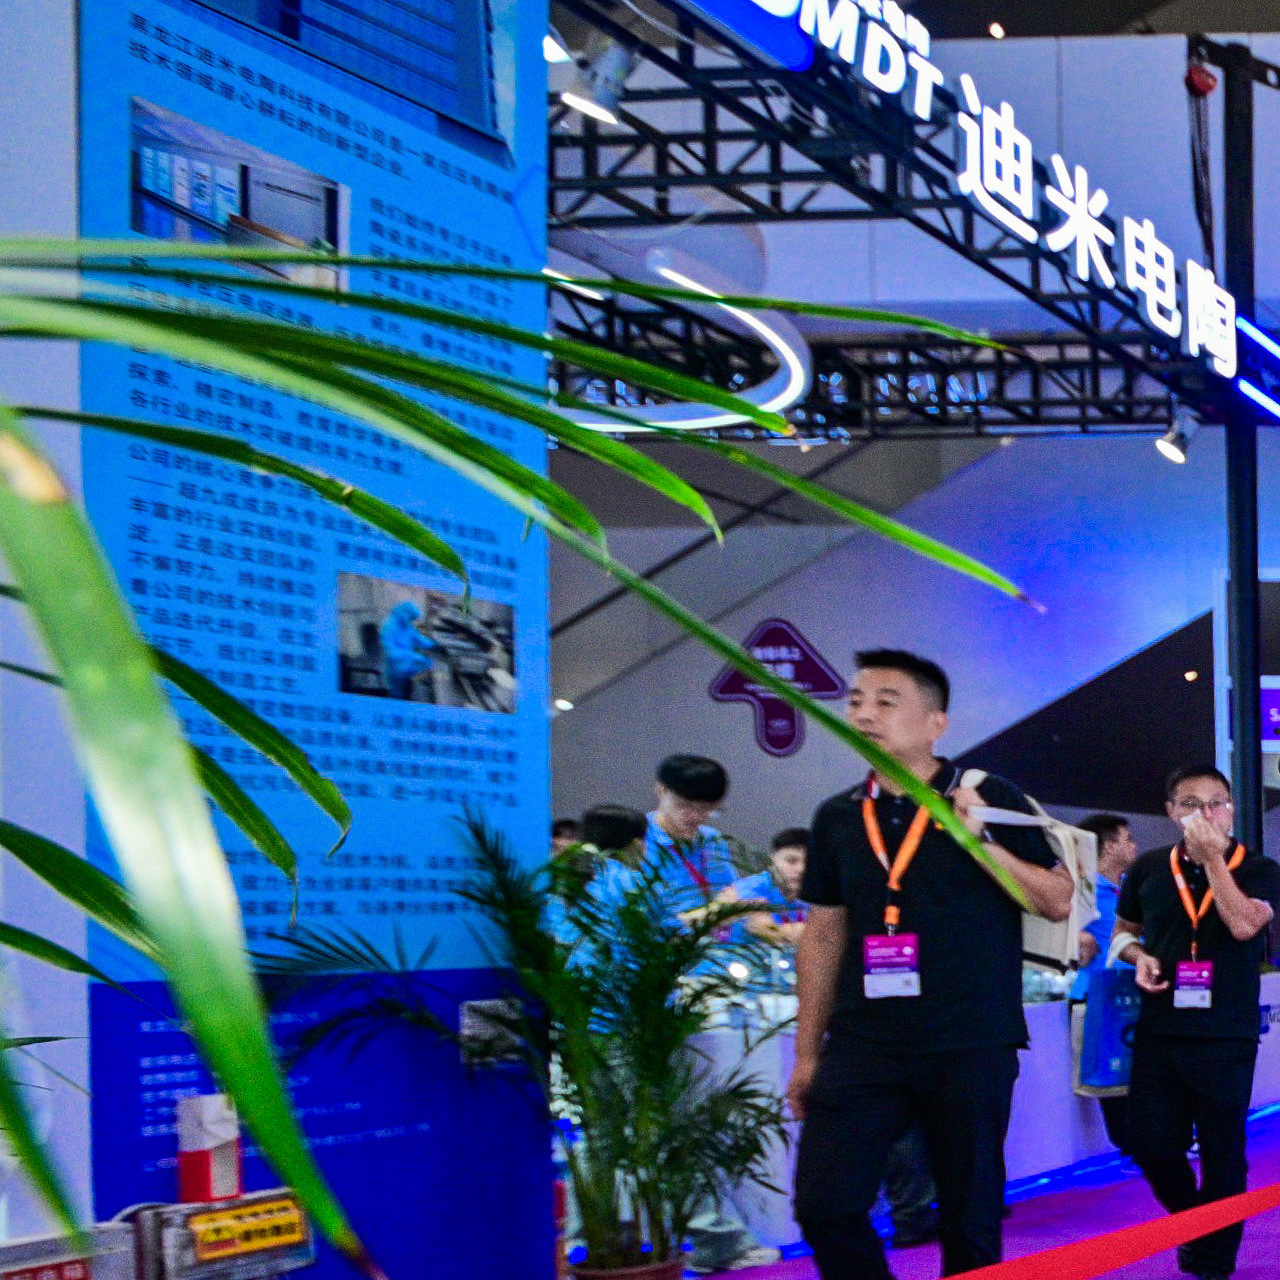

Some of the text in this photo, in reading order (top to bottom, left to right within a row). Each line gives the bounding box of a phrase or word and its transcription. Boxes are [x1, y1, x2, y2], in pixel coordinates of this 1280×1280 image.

[756, 0, 1237, 378] MDT 迪米电陶
